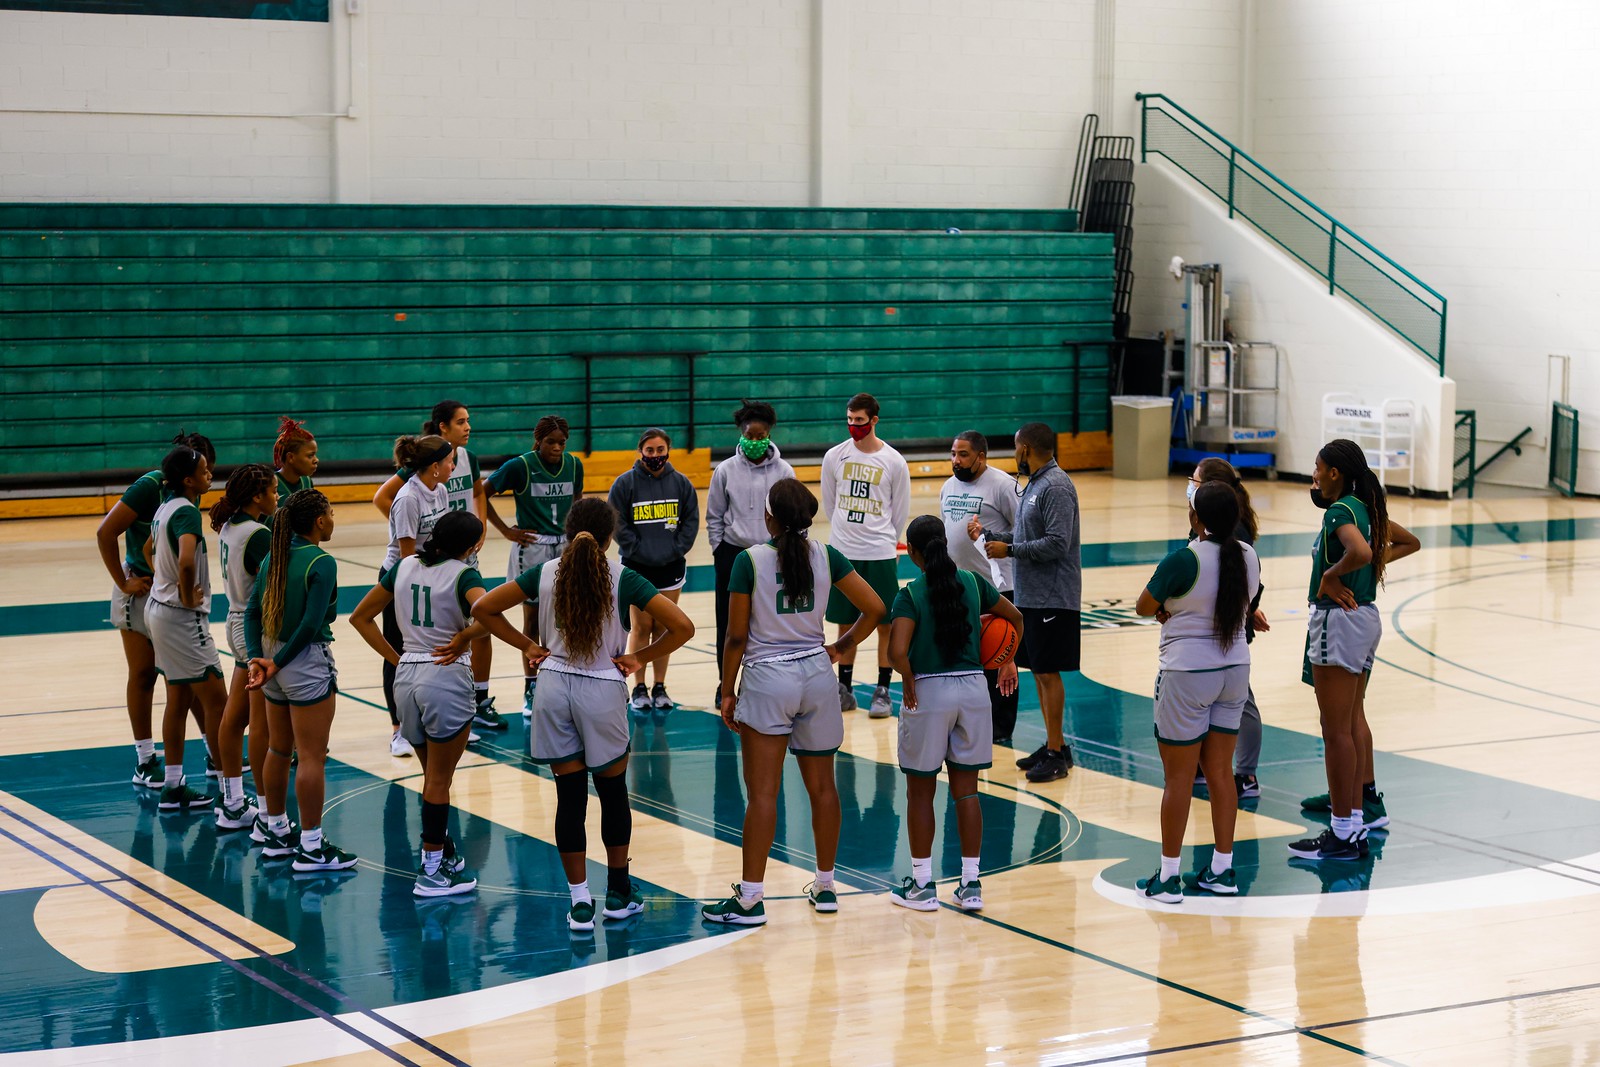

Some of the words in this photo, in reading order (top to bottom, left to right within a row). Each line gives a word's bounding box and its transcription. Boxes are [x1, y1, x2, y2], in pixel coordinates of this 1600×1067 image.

[847, 464, 878, 483] JUST
[448, 478, 465, 492] JAX
[545, 484, 564, 496] JAX
[852, 481, 867, 497] US
[551, 503, 558, 525] 1
[411, 584, 434, 627] 11
[994, 631, 1016, 664] Wilson
